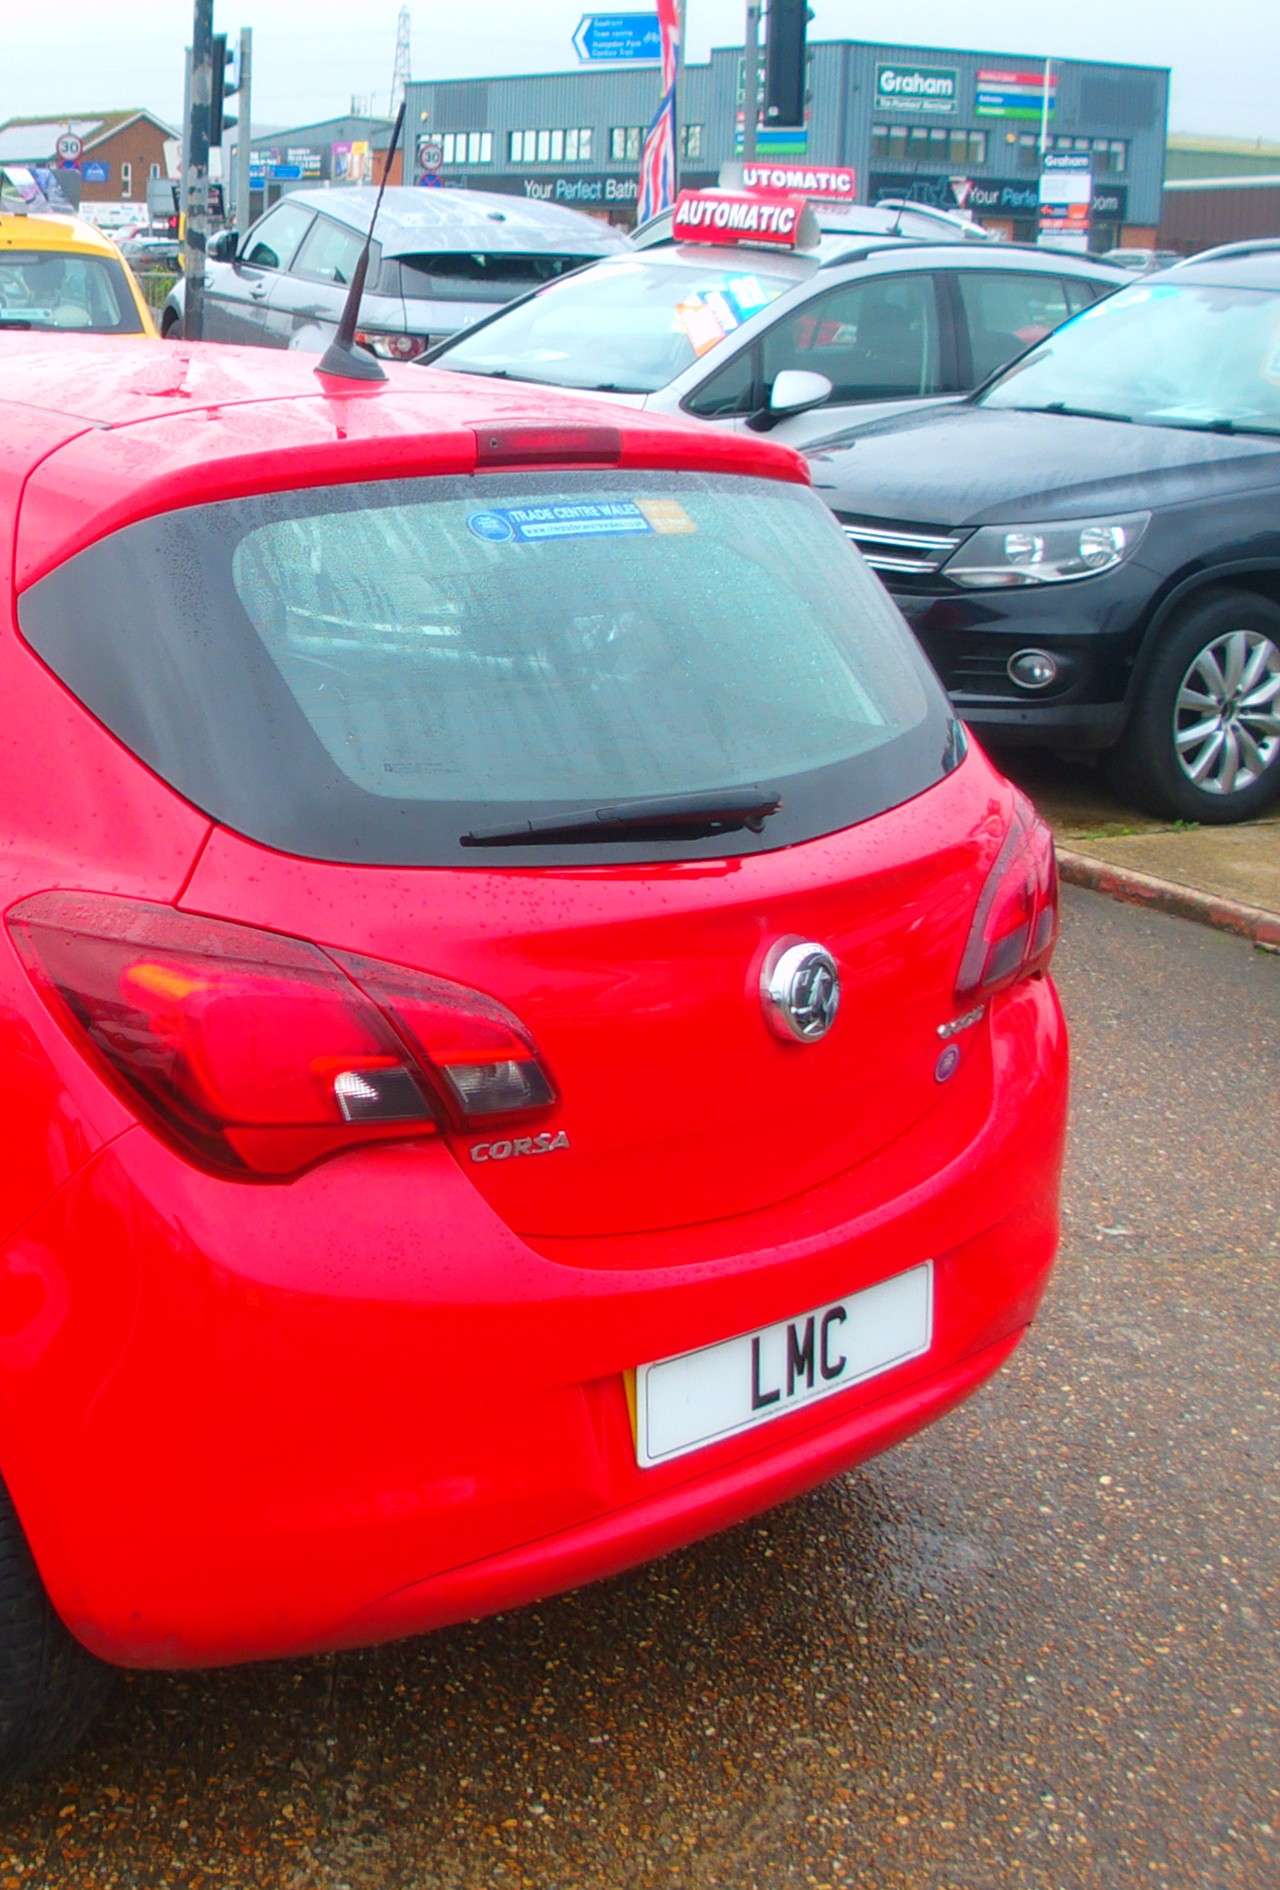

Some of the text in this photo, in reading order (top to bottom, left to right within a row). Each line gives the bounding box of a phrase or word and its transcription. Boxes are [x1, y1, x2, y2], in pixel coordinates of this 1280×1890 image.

[880, 71, 954, 96] Graham
[62, 141, 78, 153] 30
[424, 151, 440, 163] 30
[1045, 155, 1089, 167] Graham
[524, 179, 553, 199] Your
[556, 179, 602, 200] Perfect
[743, 168, 851, 192] UTOMATIC
[676, 200, 795, 233] AUTOMATIC
[509, 508, 554, 522] TRADE
[553, 505, 601, 520] CENTRE
[470, 1130, 570, 1163] CORSA
[751, 1305, 847, 1411] LMC
